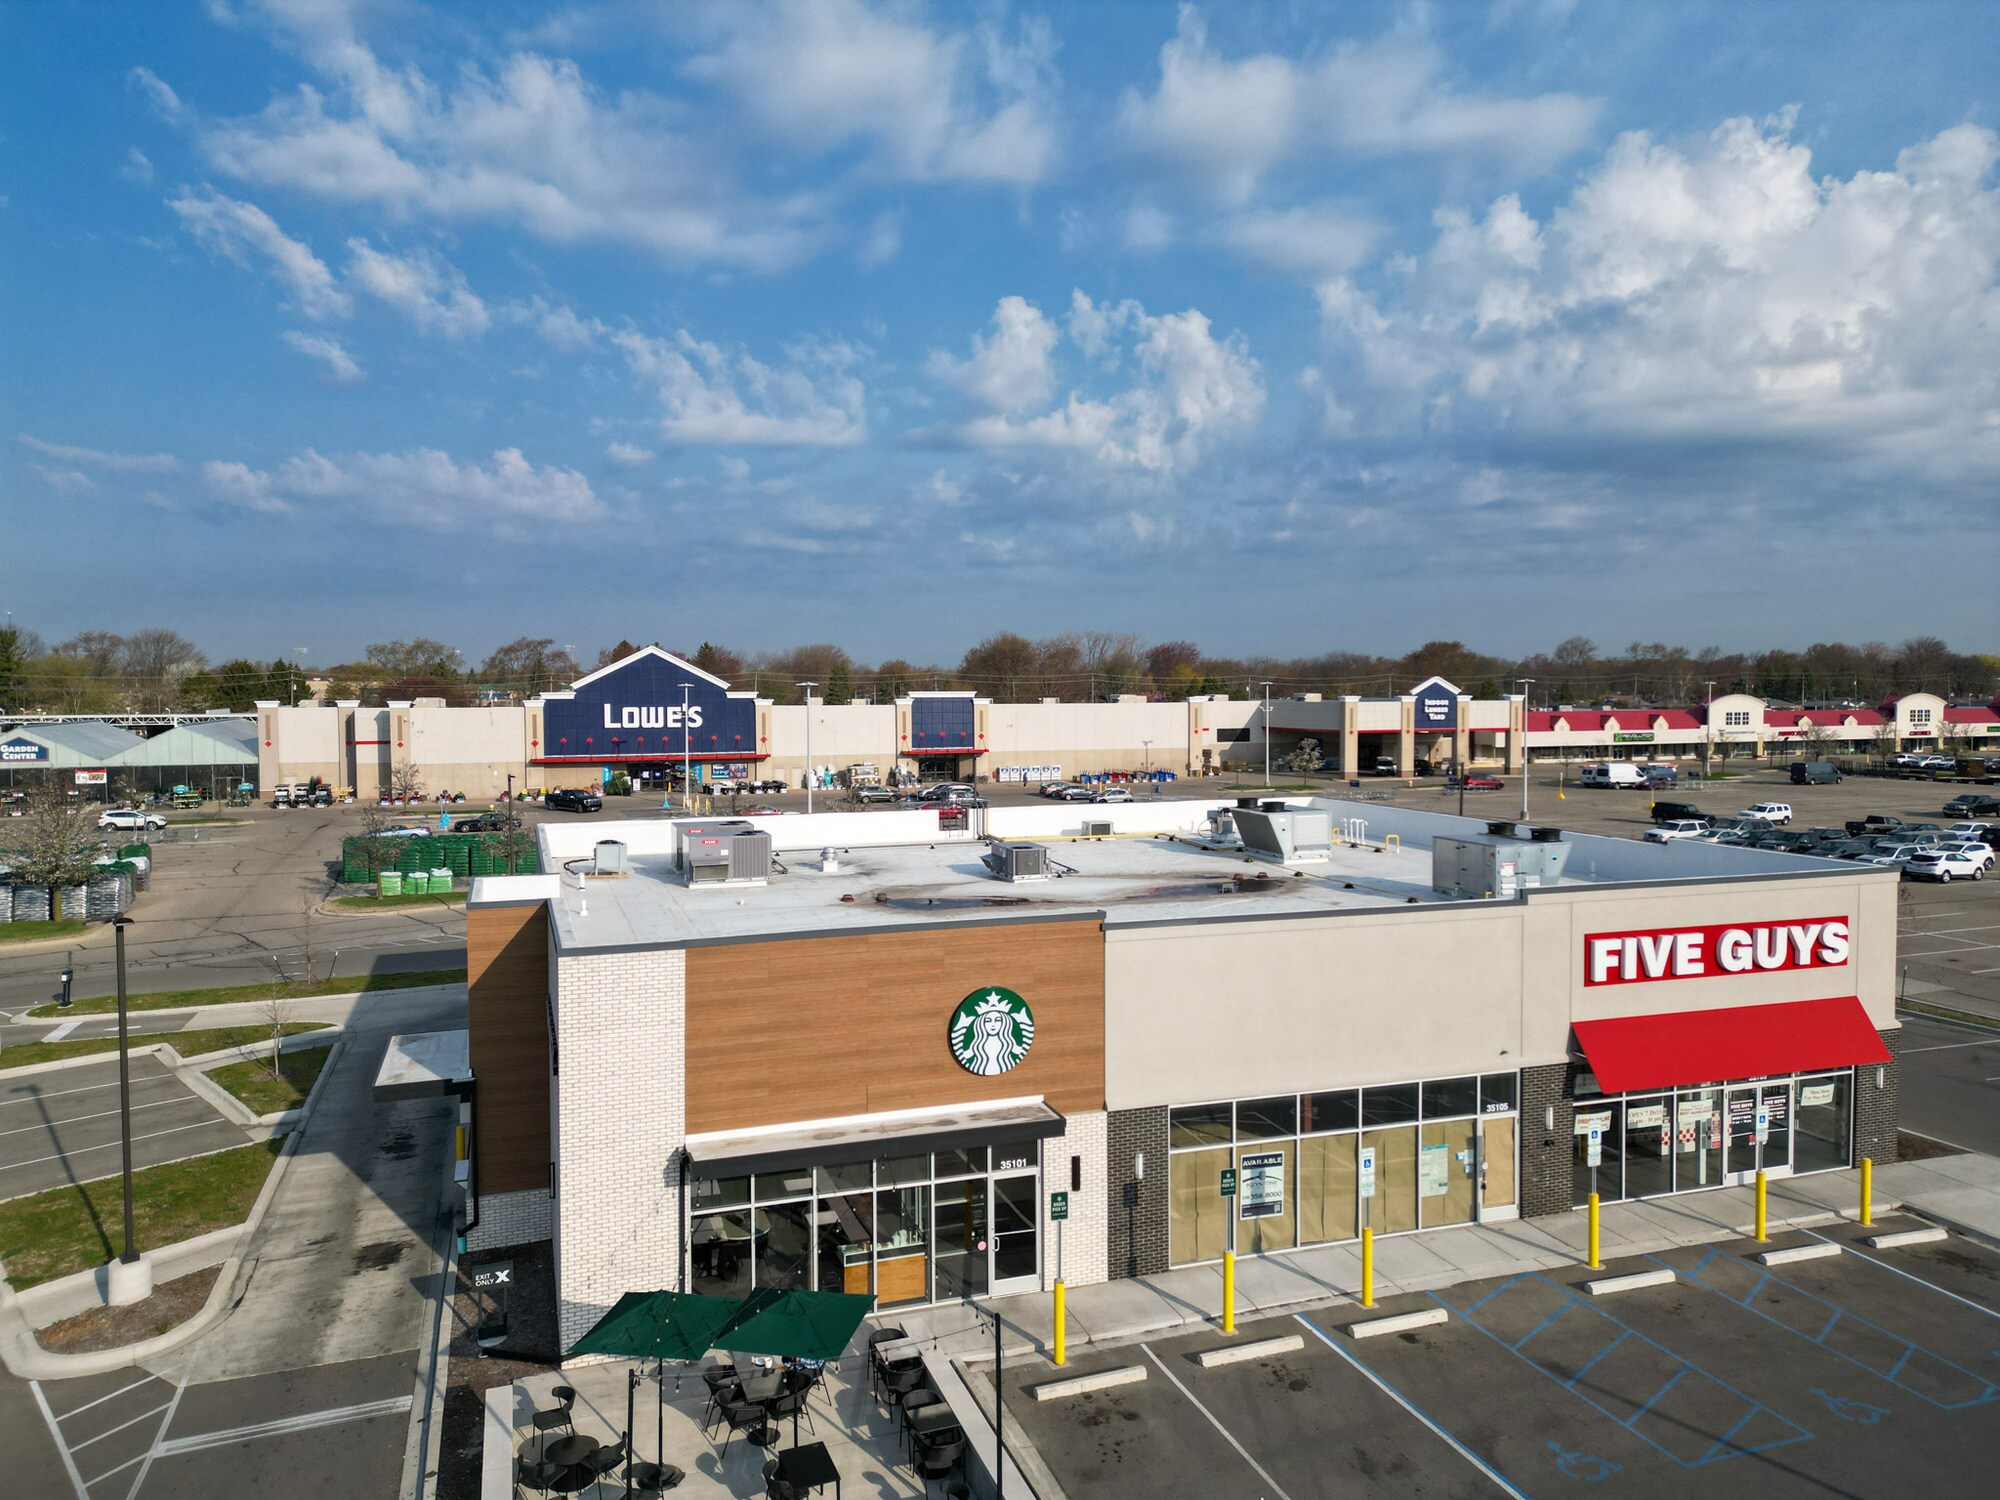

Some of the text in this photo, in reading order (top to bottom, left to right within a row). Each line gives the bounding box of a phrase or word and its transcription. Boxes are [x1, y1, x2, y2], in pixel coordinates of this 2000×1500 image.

[603, 703, 703, 729] LOWE'S
[2, 752, 37, 760] CENTER
[1590, 922, 1849, 982] FIVE GUYS
[1486, 1102, 1509, 1112] 35105
[1000, 1158, 1027, 1170] 35101
[1242, 1157, 1282, 1167] AVAILABLE
[475, 1273, 491, 1281] EXIT
[475, 1278, 495, 1287] ONLY
